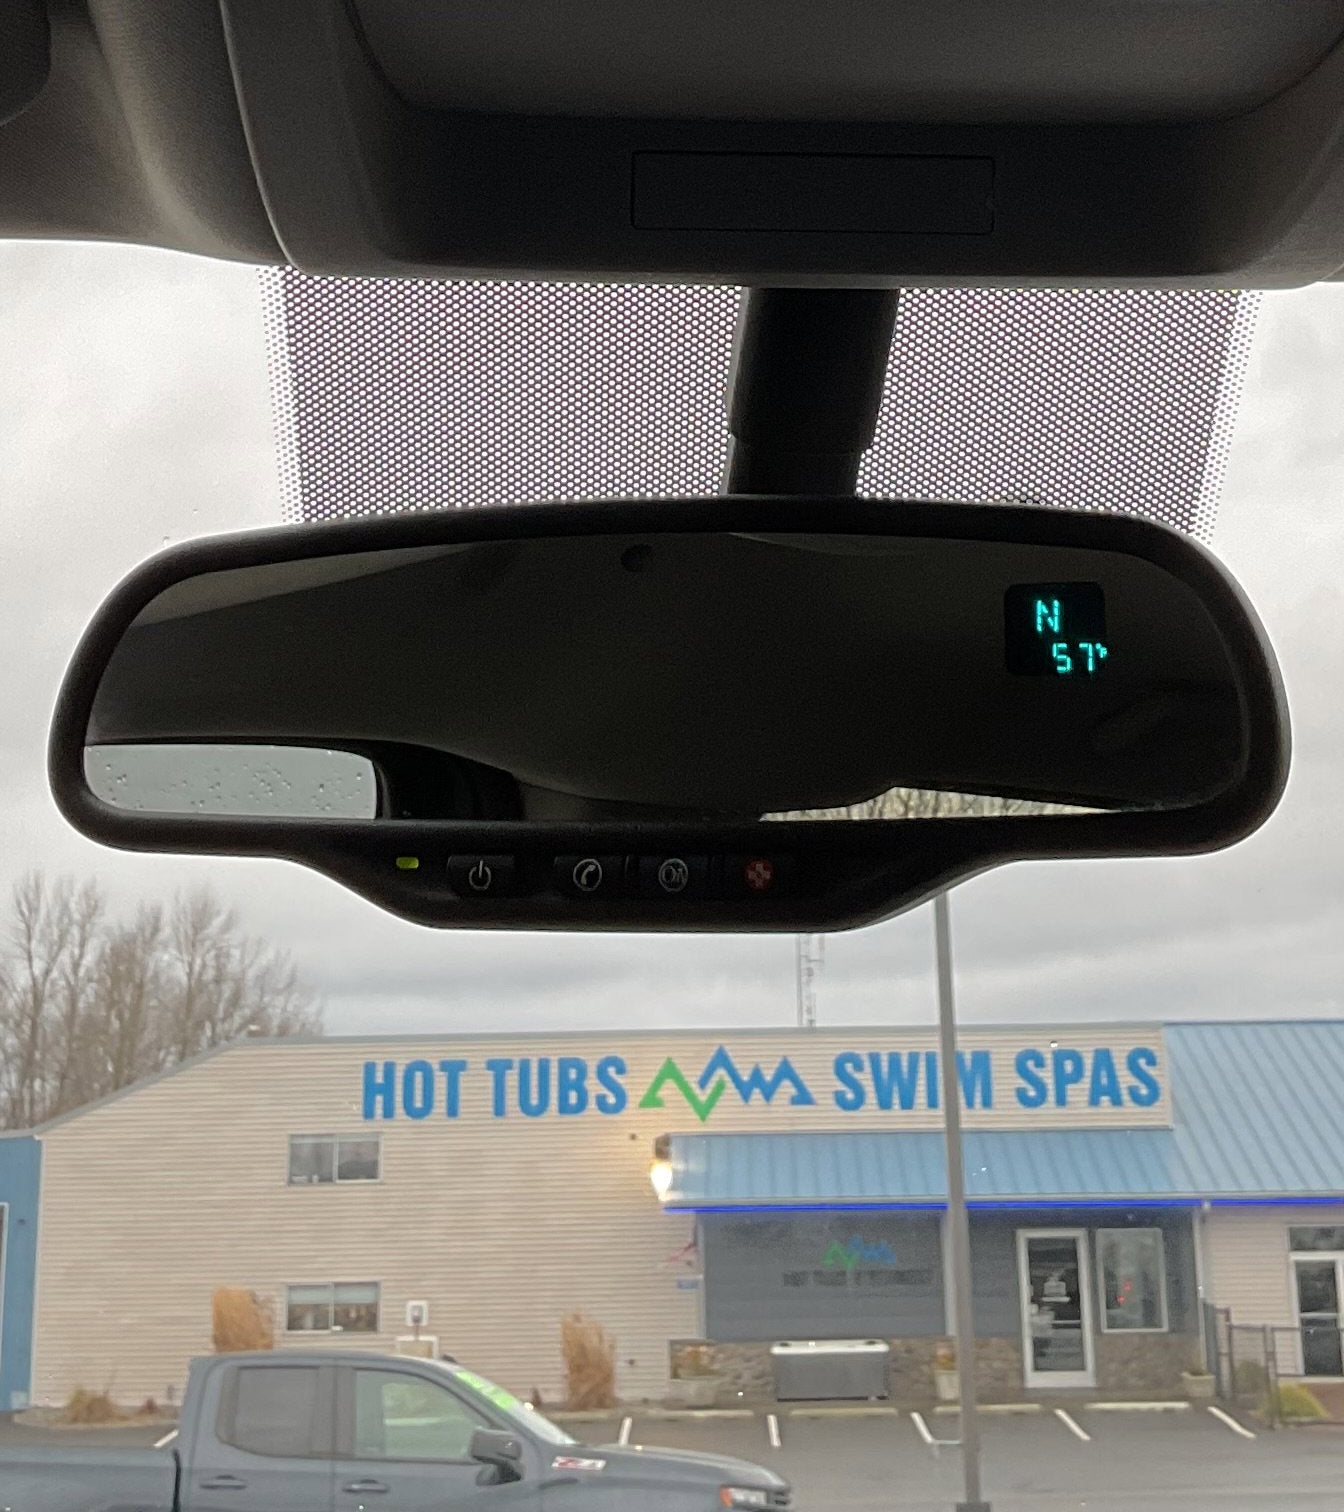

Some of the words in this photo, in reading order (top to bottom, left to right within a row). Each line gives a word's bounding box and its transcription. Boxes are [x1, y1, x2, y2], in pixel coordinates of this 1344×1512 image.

[1035, 598, 1060, 634] N
[362, 1059, 468, 1120] HOT
[485, 1055, 629, 1118] TUBS
[832, 1050, 994, 1111] SWIM
[1013, 1046, 1162, 1108] SPAS
